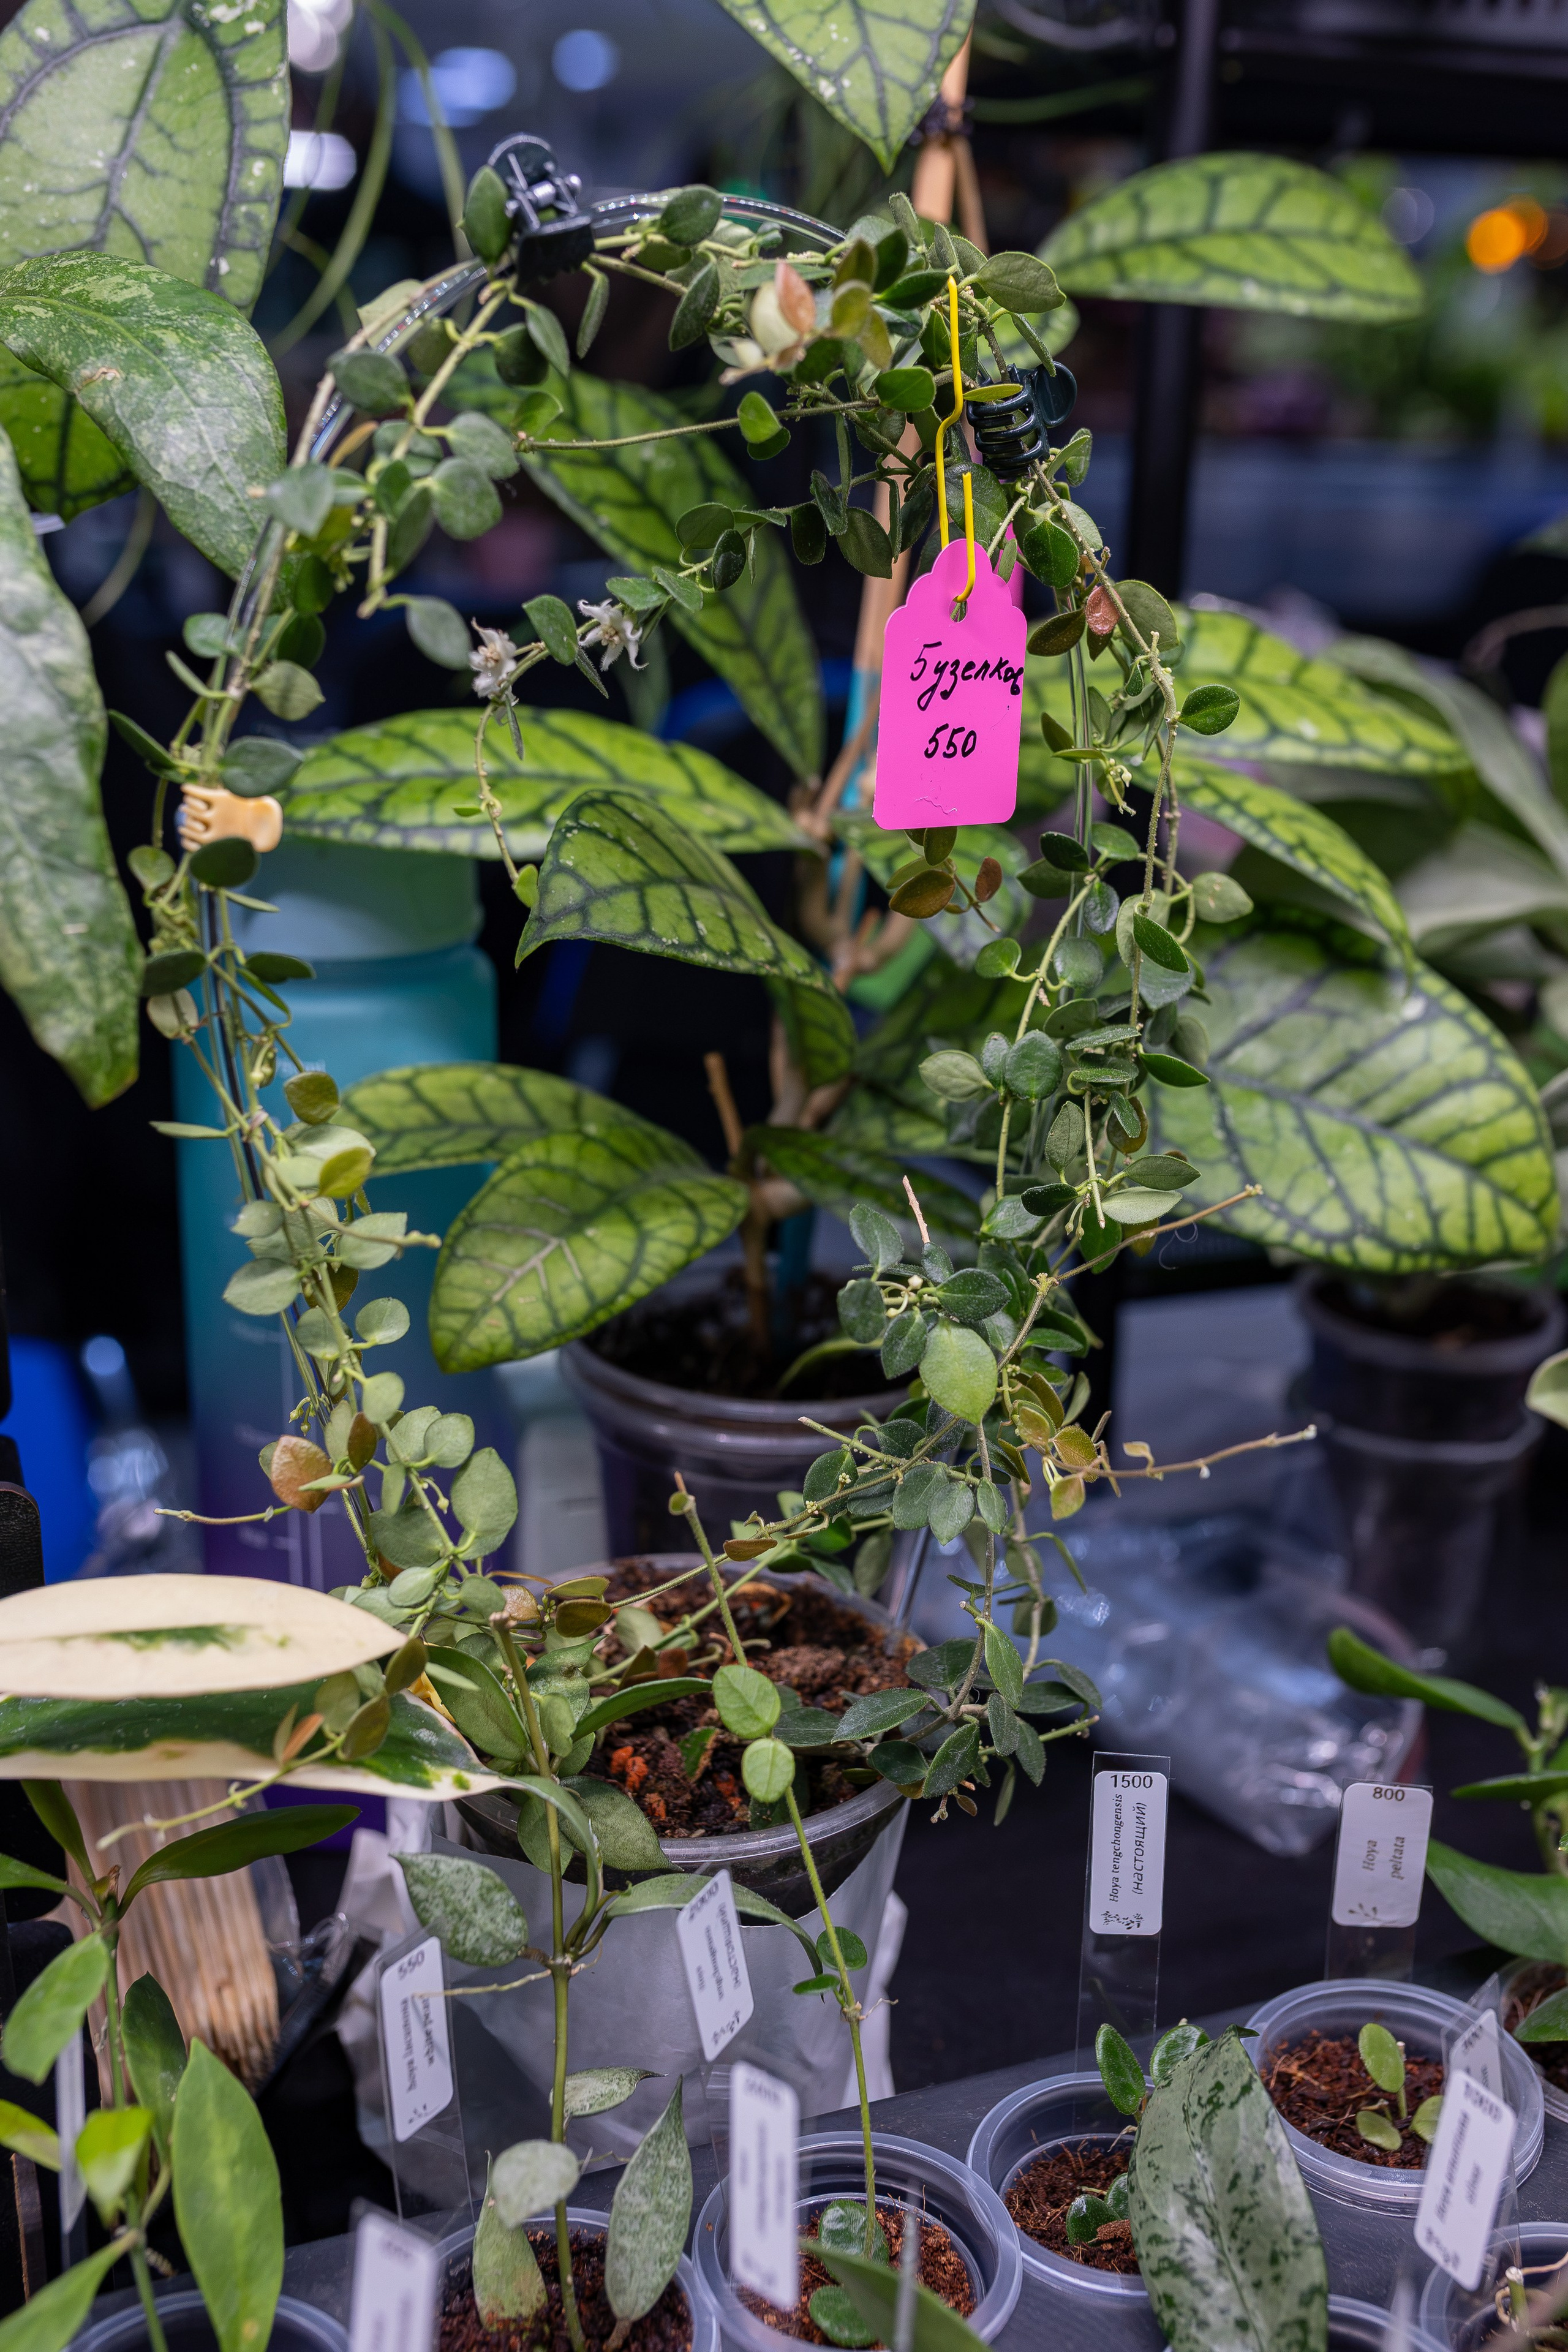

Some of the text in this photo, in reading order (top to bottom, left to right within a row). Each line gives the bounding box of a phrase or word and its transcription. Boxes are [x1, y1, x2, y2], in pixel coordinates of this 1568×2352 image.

[924, 723, 977, 759] 550
[1110, 1774, 1153, 1789] 1500
[1373, 1787, 1405, 1801] 800
[1109, 1793, 1125, 1902] Hoya tengchongensis
[1132, 1802, 1147, 1894] (настоящий)
[1362, 1839, 1379, 1871] Hoya
[1390, 1836, 1406, 1880] peltata
[398, 1950, 425, 1981] 550
